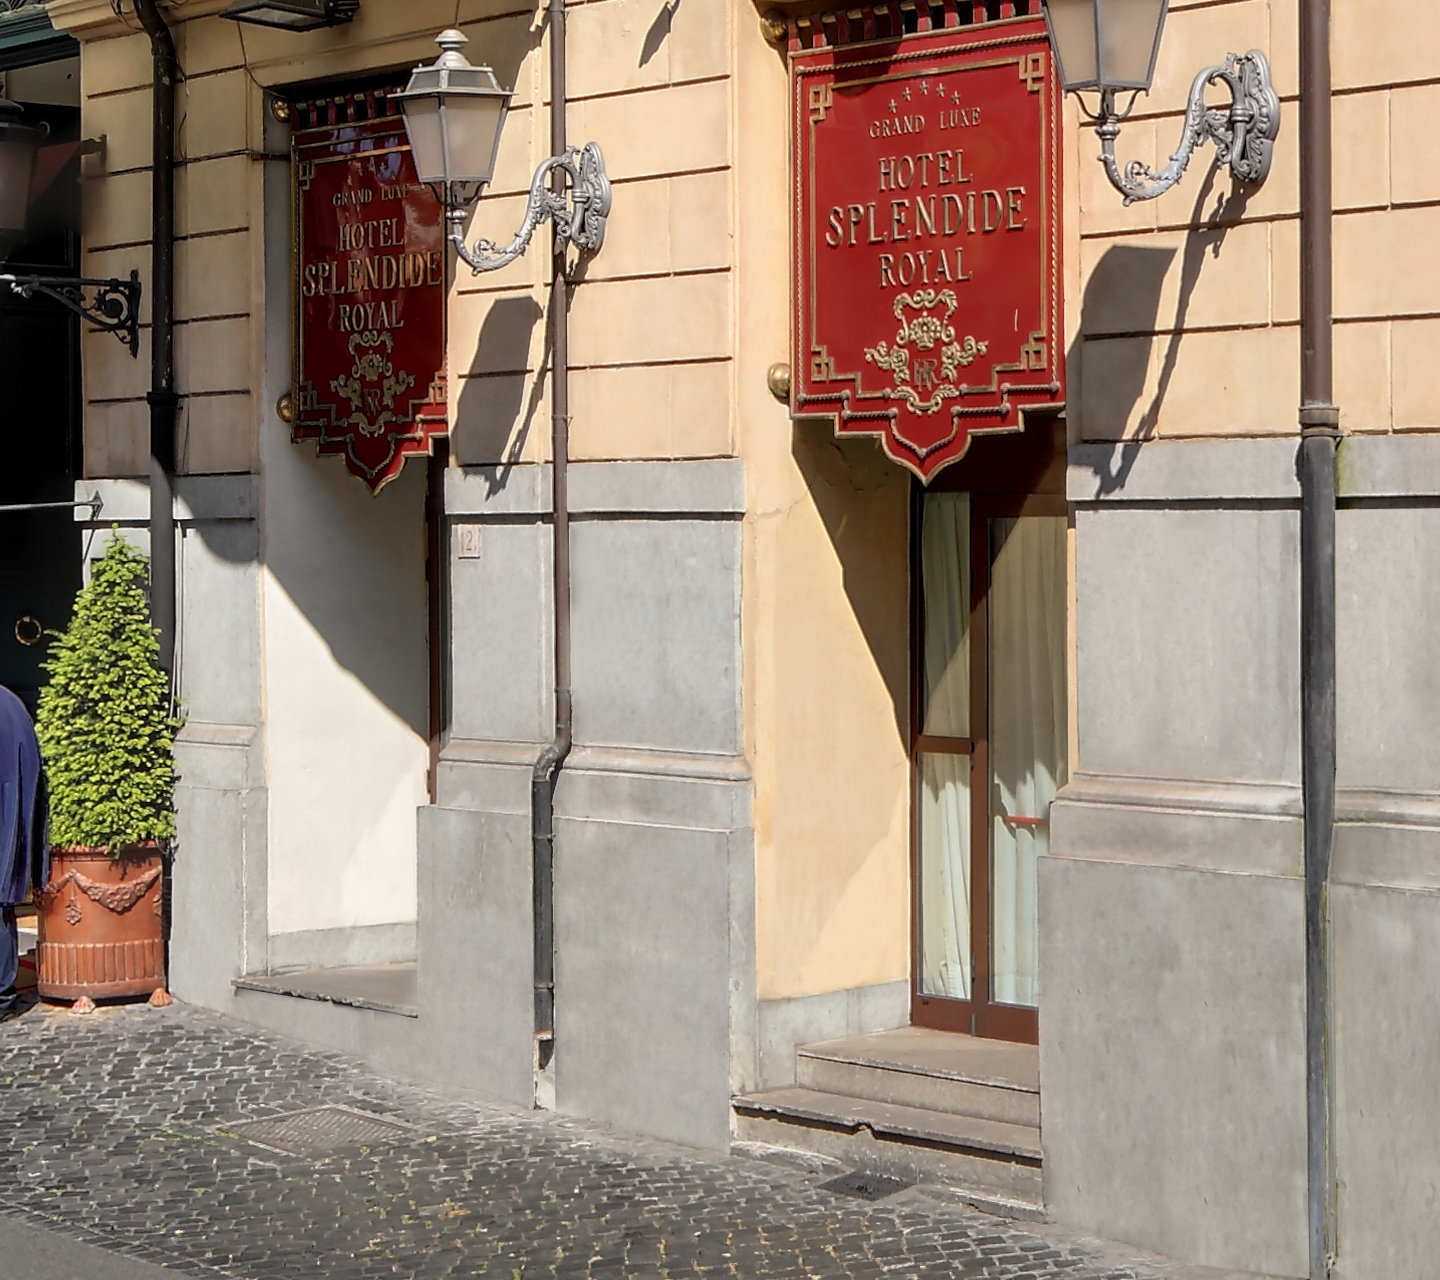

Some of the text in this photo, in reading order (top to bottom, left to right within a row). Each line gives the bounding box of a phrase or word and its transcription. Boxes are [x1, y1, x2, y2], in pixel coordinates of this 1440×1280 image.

[870, 107, 981, 138] GRAND LUXE
[879, 149, 973, 191] HOTEL
[332, 183, 410, 206] GRAND LUXE
[825, 186, 1028, 246] SPLENDIDE
[338, 218, 406, 251] HOTEL
[302, 250, 443, 297] SPLENDIDE
[879, 247, 973, 287] ROYAL
[339, 300, 404, 332] ROYAL
